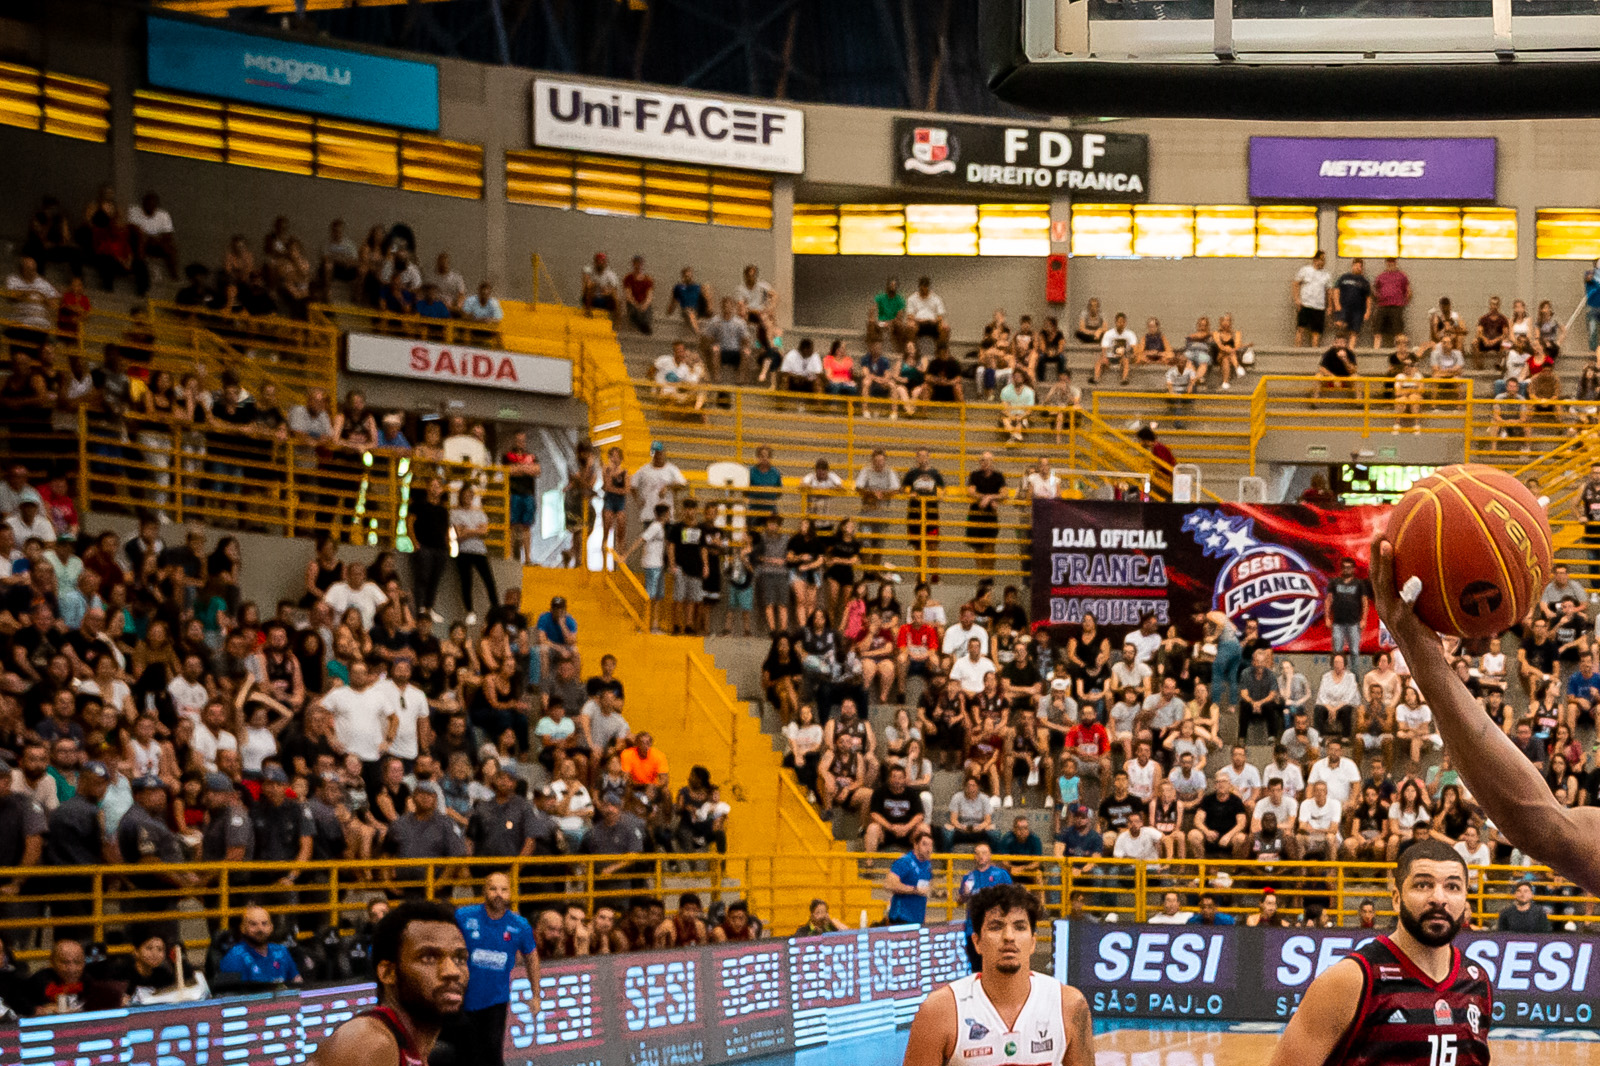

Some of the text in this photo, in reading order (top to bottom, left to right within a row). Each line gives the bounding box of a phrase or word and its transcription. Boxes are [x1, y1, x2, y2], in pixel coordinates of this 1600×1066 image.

[549, 87, 786, 145] Uni-FACEF
[967, 163, 1052, 187] DIREITO
[1319, 159, 1427, 178] NETSHOES
[1051, 527, 1168, 549] LOJA OFICIAL
[1050, 553, 1168, 587] FRANCA
[1237, 556, 1281, 580] SESI
[1228, 574, 1314, 612] FRANCA
[1094, 932, 1224, 984] SESI
[1276, 935, 1380, 986] SE
[1464, 940, 1593, 992] SESI
[509, 973, 593, 1050] SESI
[624, 960, 697, 1032] SESI
[1149, 994, 1224, 1016] PAULO
